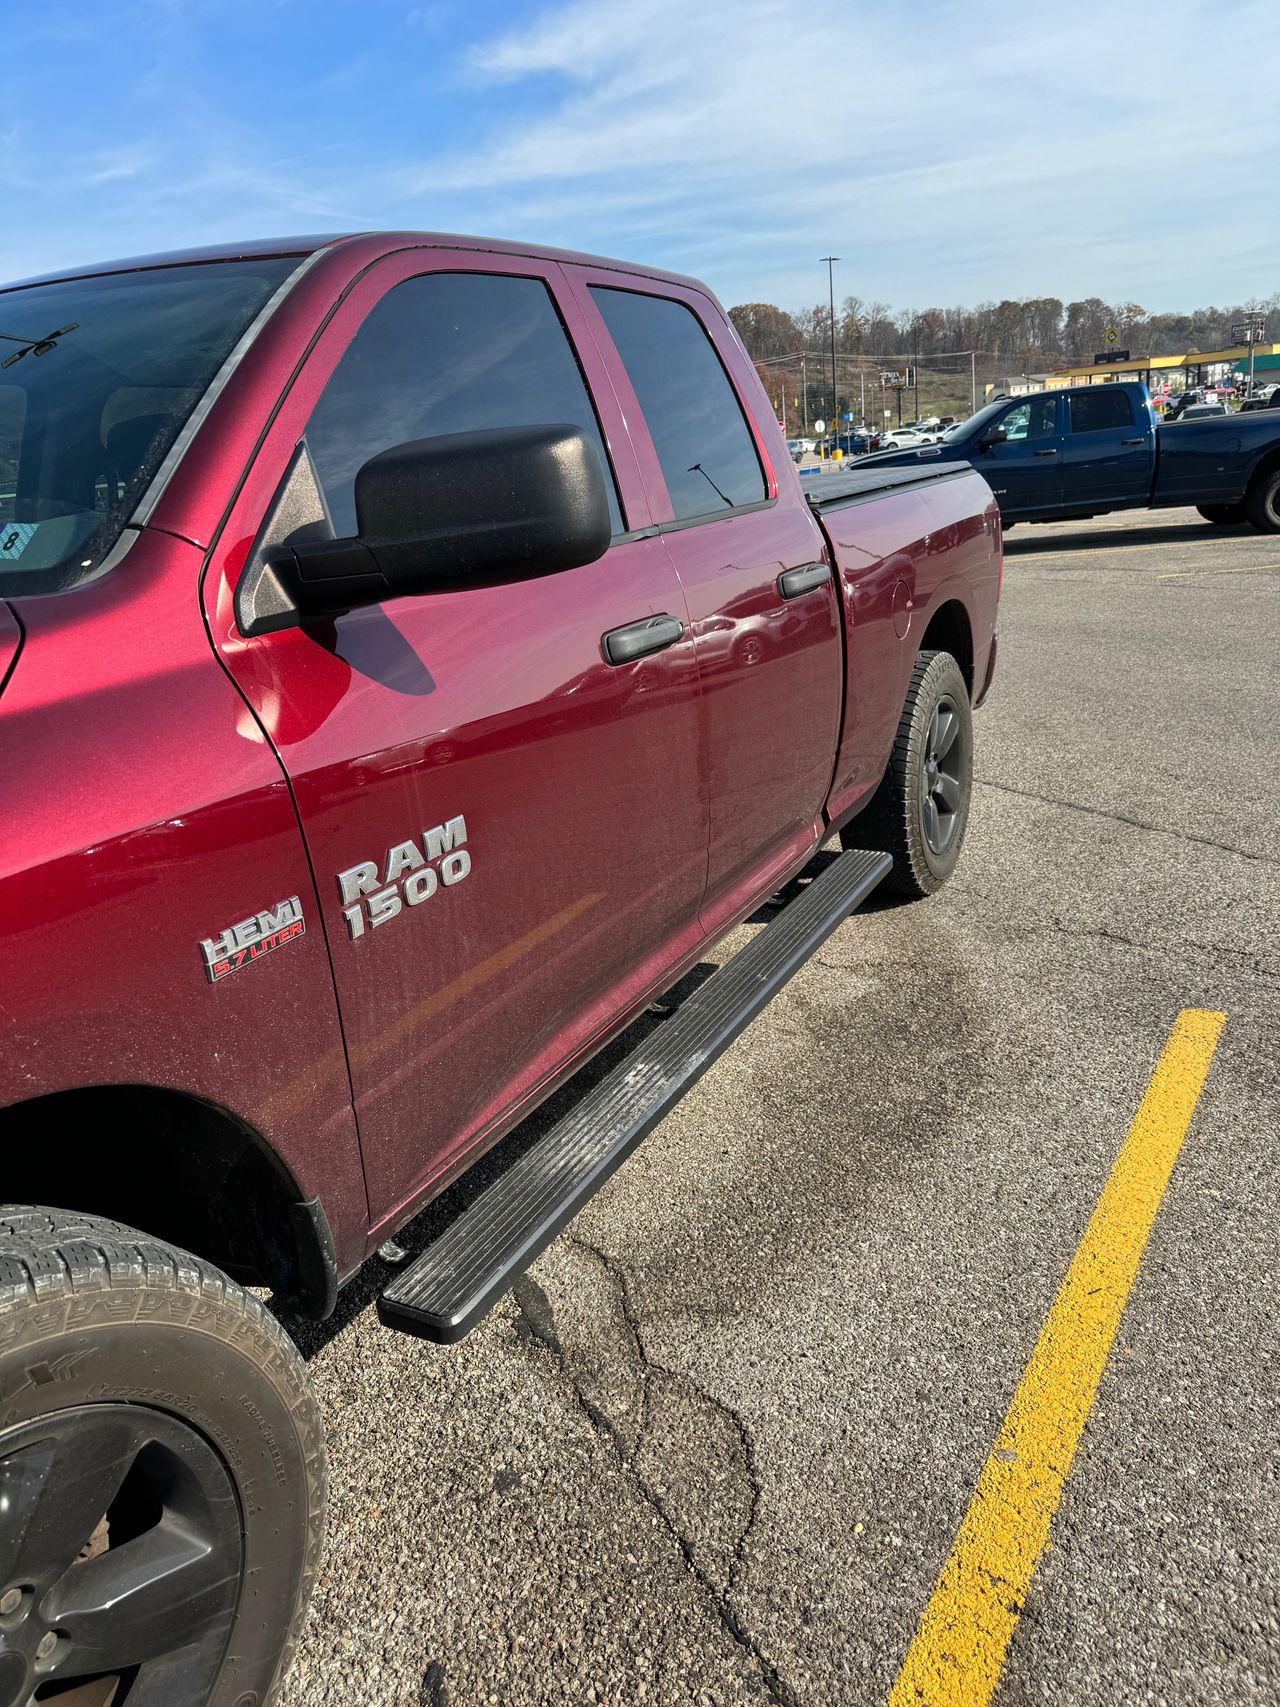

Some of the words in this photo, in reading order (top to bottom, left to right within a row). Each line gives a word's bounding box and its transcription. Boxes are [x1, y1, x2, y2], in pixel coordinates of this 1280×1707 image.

[2, 531, 20, 551] 8
[337, 814, 467, 906] RAM
[200, 895, 303, 964] HEMI
[343, 850, 472, 940] 1500
[213, 949, 247, 977] 5.7
[250, 921, 303, 958] LITER
